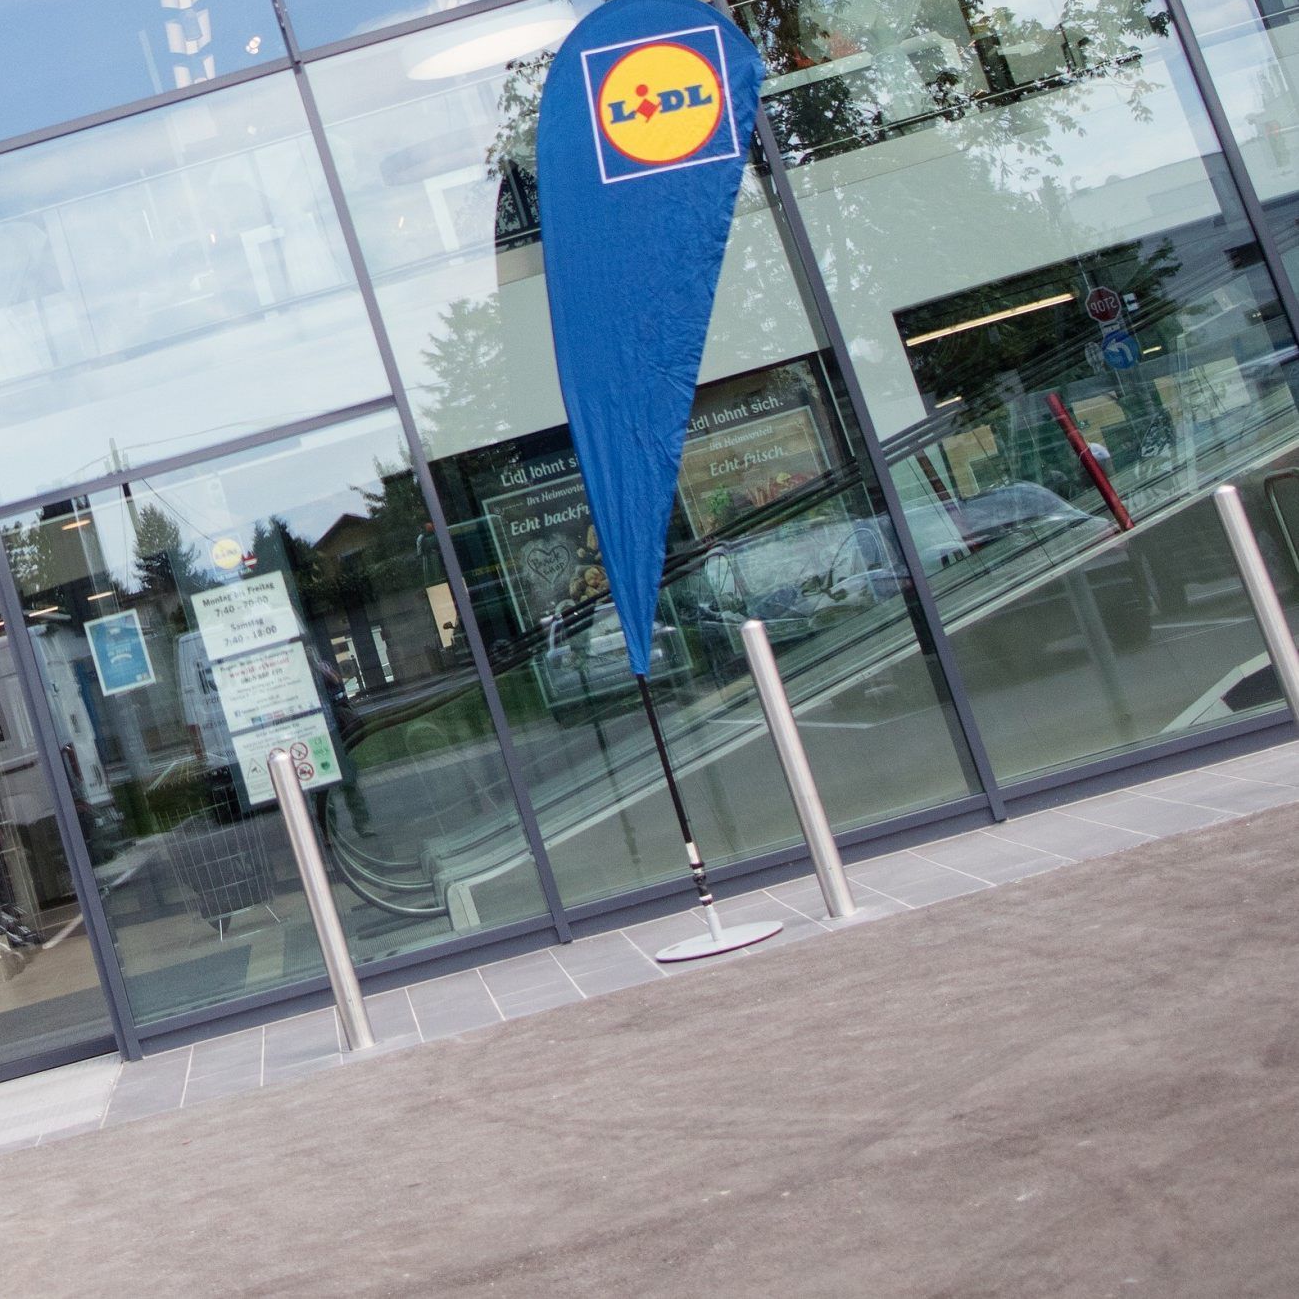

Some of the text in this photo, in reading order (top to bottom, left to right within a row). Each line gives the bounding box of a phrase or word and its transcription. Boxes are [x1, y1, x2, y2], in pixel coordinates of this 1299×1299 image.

[714, 404, 749, 425] lohnt
[751, 396, 784, 414] sich.
[500, 469, 529, 487] Lidl
[529, 459, 567, 479] lohnt
[710, 459, 741, 477] Echt
[526, 483, 585, 508] Ihr Heimvorte
[510, 501, 591, 536] Echt backfr
[202, 592, 232, 608] Montag
[247, 580, 276, 595] Freitag
[230, 616, 264, 632] Samstag
